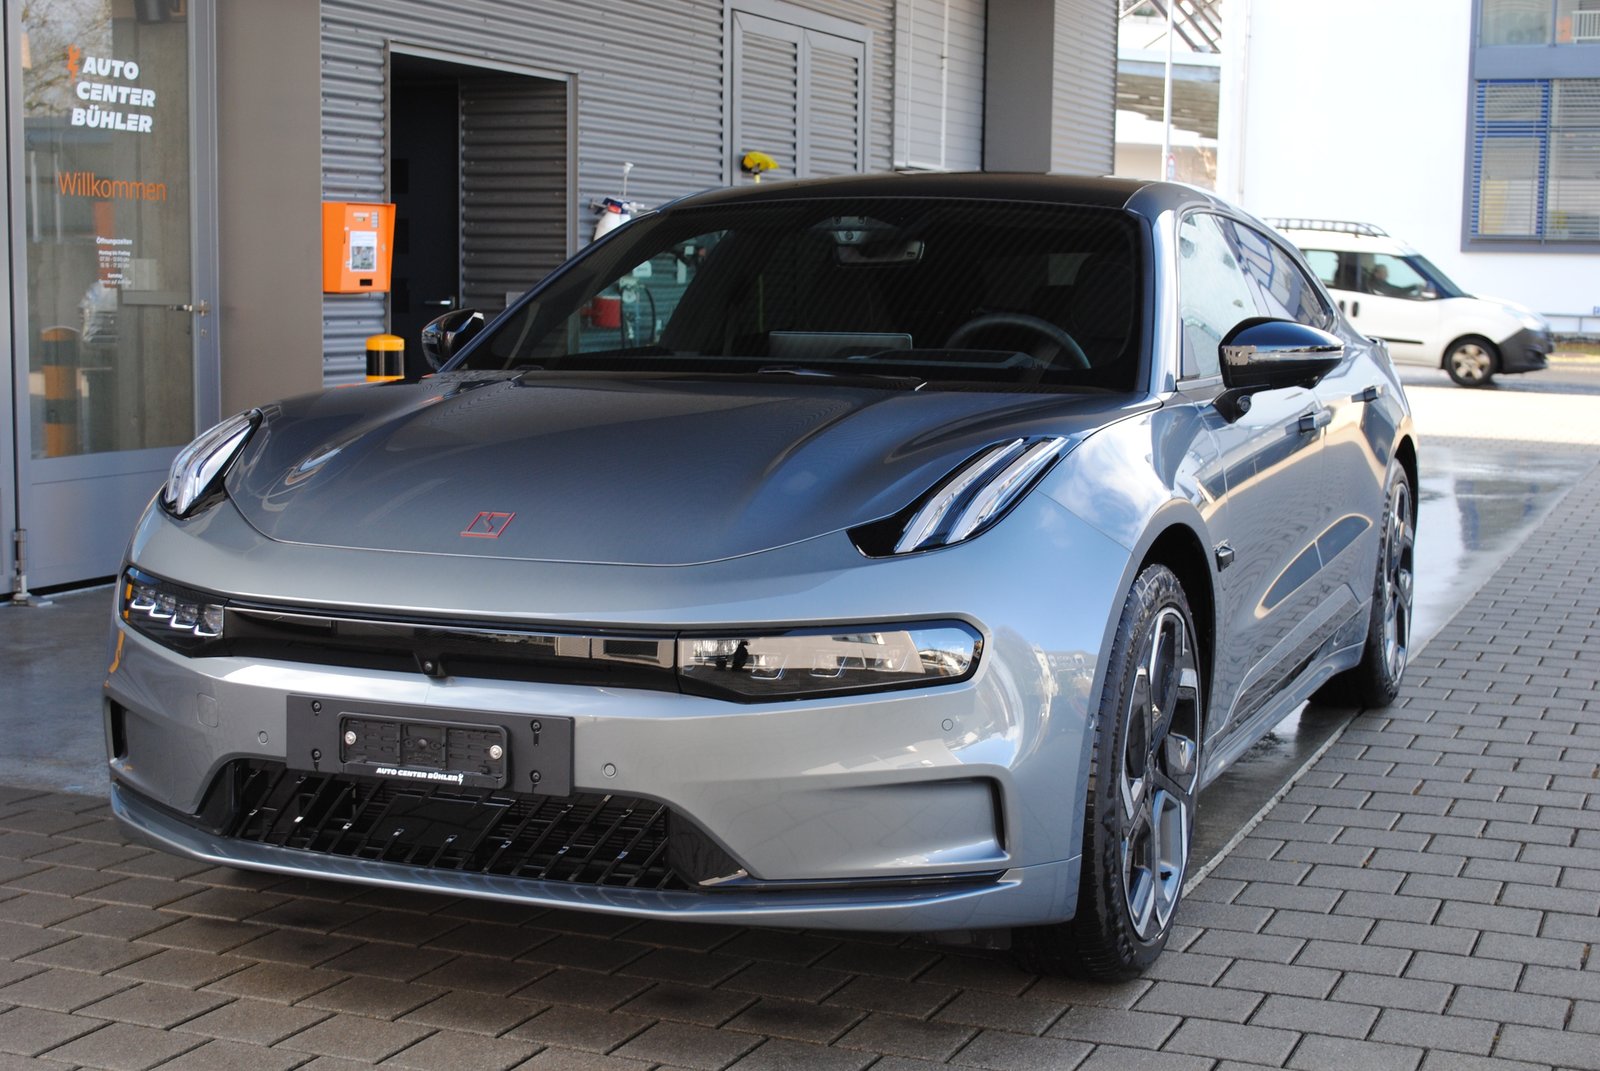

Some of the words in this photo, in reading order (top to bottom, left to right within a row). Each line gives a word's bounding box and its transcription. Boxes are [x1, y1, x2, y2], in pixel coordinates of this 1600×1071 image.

[82, 56, 139, 80] AUTO
[76, 82, 156, 107] CENTER
[71, 104, 153, 133] BÜHLER
[58, 171, 167, 202] Willkommen
[376, 767, 397, 776] AUTO
[397, 769, 427, 779] CENTER
[427, 771, 459, 782] BÜHLER
